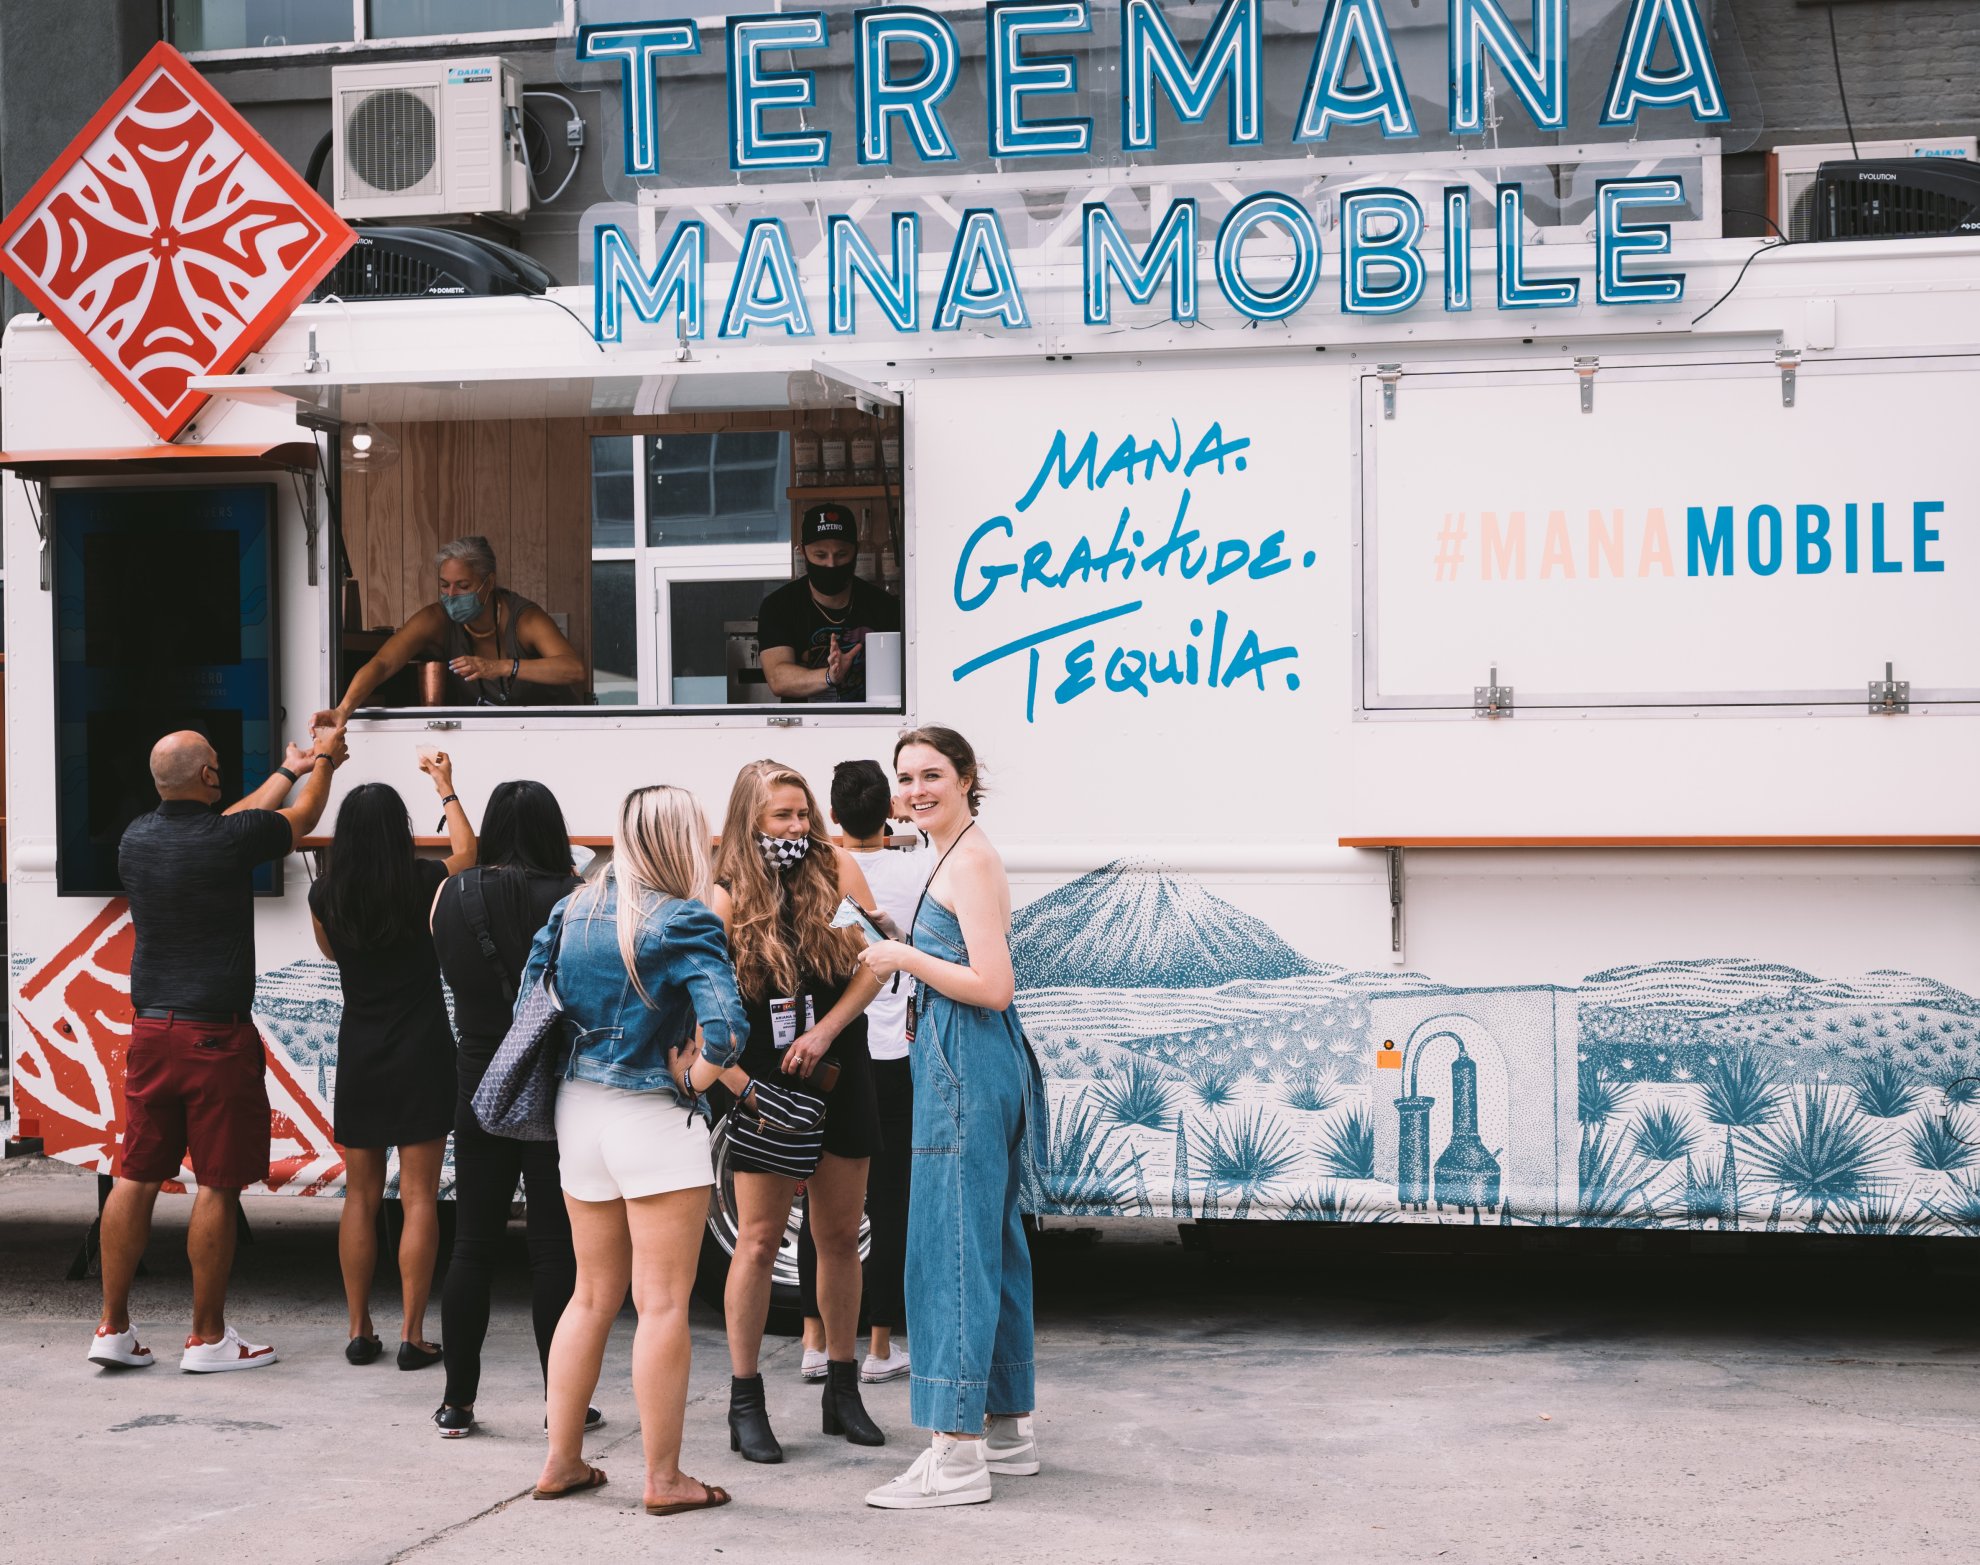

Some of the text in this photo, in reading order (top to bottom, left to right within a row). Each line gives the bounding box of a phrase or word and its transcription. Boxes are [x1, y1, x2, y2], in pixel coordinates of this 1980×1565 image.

[456, 67, 492, 76] DAIKIN
[577, 0, 1729, 176] TEREMANA
[1925, 147, 1966, 157] DAIKIN
[1859, 172, 1897, 181] EVOLUTION
[594, 174, 1687, 344] MANA MOBILE
[1015, 416, 1251, 513] MANA.
[819, 512, 826, 524] I
[1433, 500, 1945, 582] #MANAMOBILE
